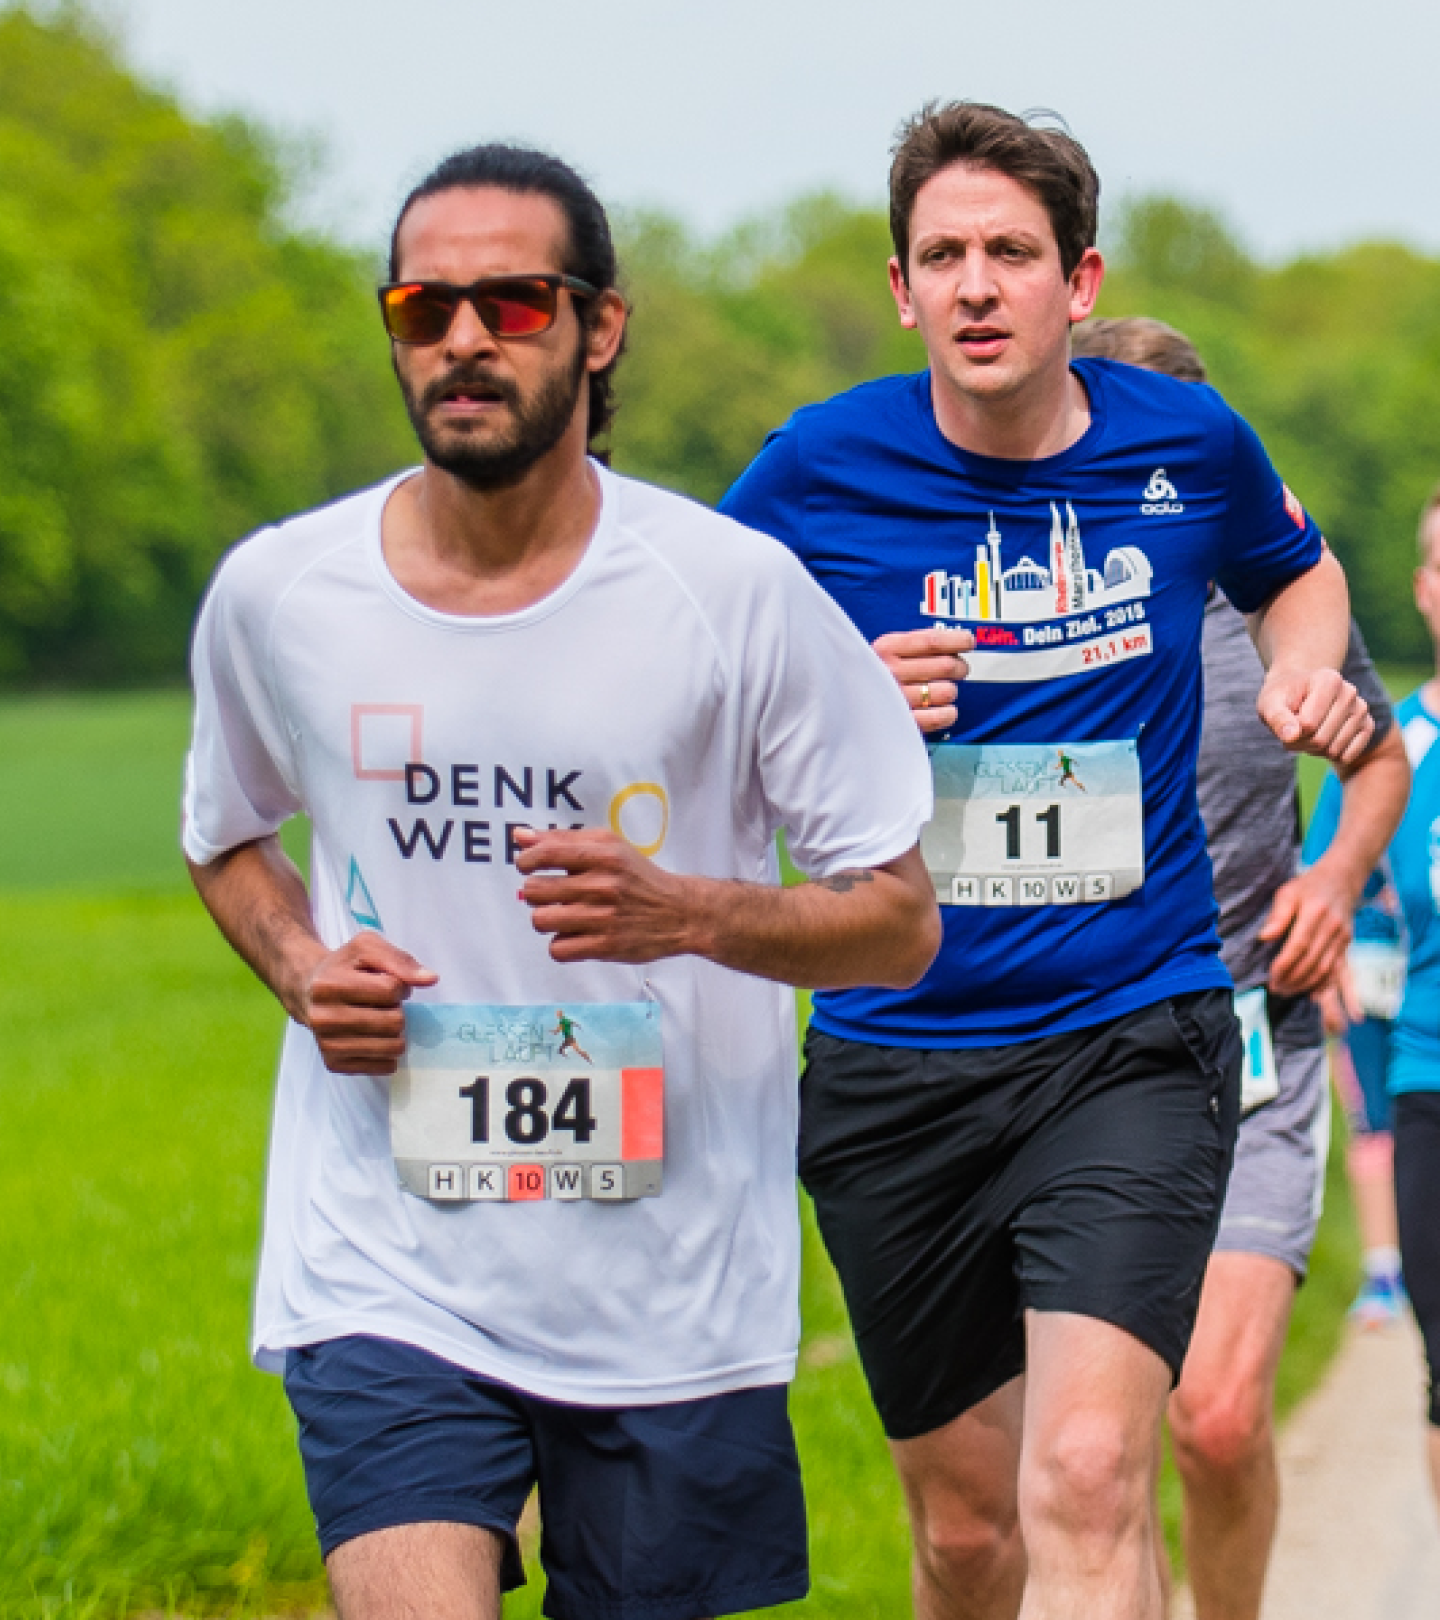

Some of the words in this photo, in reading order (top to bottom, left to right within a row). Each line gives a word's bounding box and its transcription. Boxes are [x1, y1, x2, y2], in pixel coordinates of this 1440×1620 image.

[1022, 625, 1063, 646] Dein
[1081, 639, 1117, 665] 21,1
[1122, 633, 1149, 652] km
[404, 762, 584, 812] DENK
[995, 804, 1061, 860] 11
[956, 880, 973, 898] H
[992, 880, 1008, 898] K
[1023, 880, 1045, 898] 10
[458, 1074, 598, 1145] 184
[434, 1170, 455, 1191] H
[476, 1170, 495, 1192] K
[515, 1170, 542, 1192] 10
[556, 1169, 580, 1191] W
[599, 1169, 616, 1191] 5
